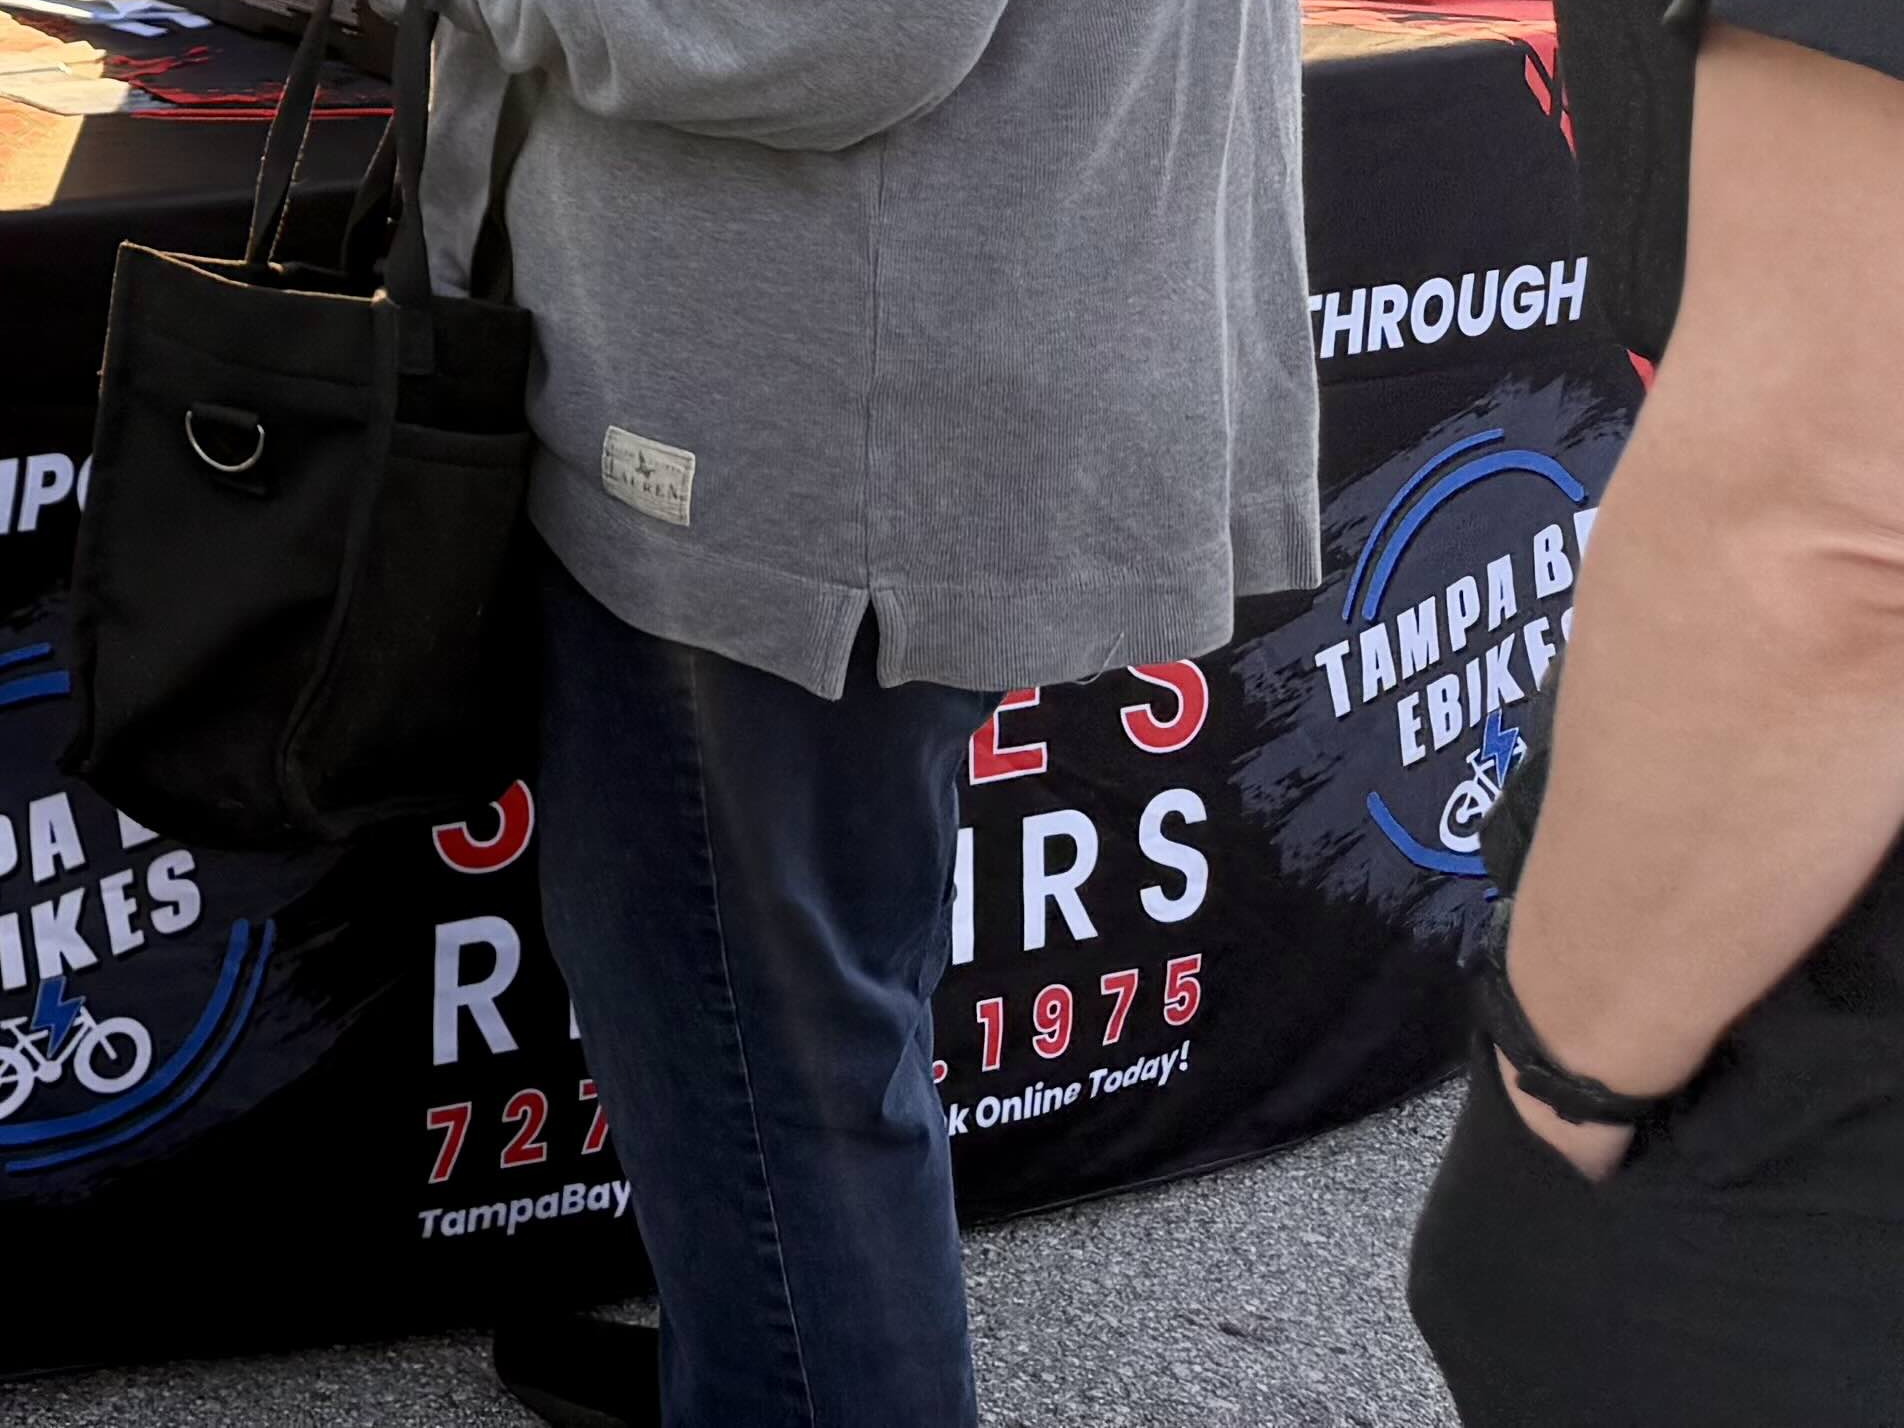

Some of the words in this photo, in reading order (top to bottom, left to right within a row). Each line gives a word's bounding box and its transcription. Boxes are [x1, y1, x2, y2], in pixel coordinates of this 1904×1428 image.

[1307, 256, 1589, 360] HROUGH
[1314, 551, 1519, 720] TAMPA
[1396, 606, 1575, 768] EBIKE
[975, 1081, 1082, 1130] Online
[1088, 1039, 1191, 1100] Today!
